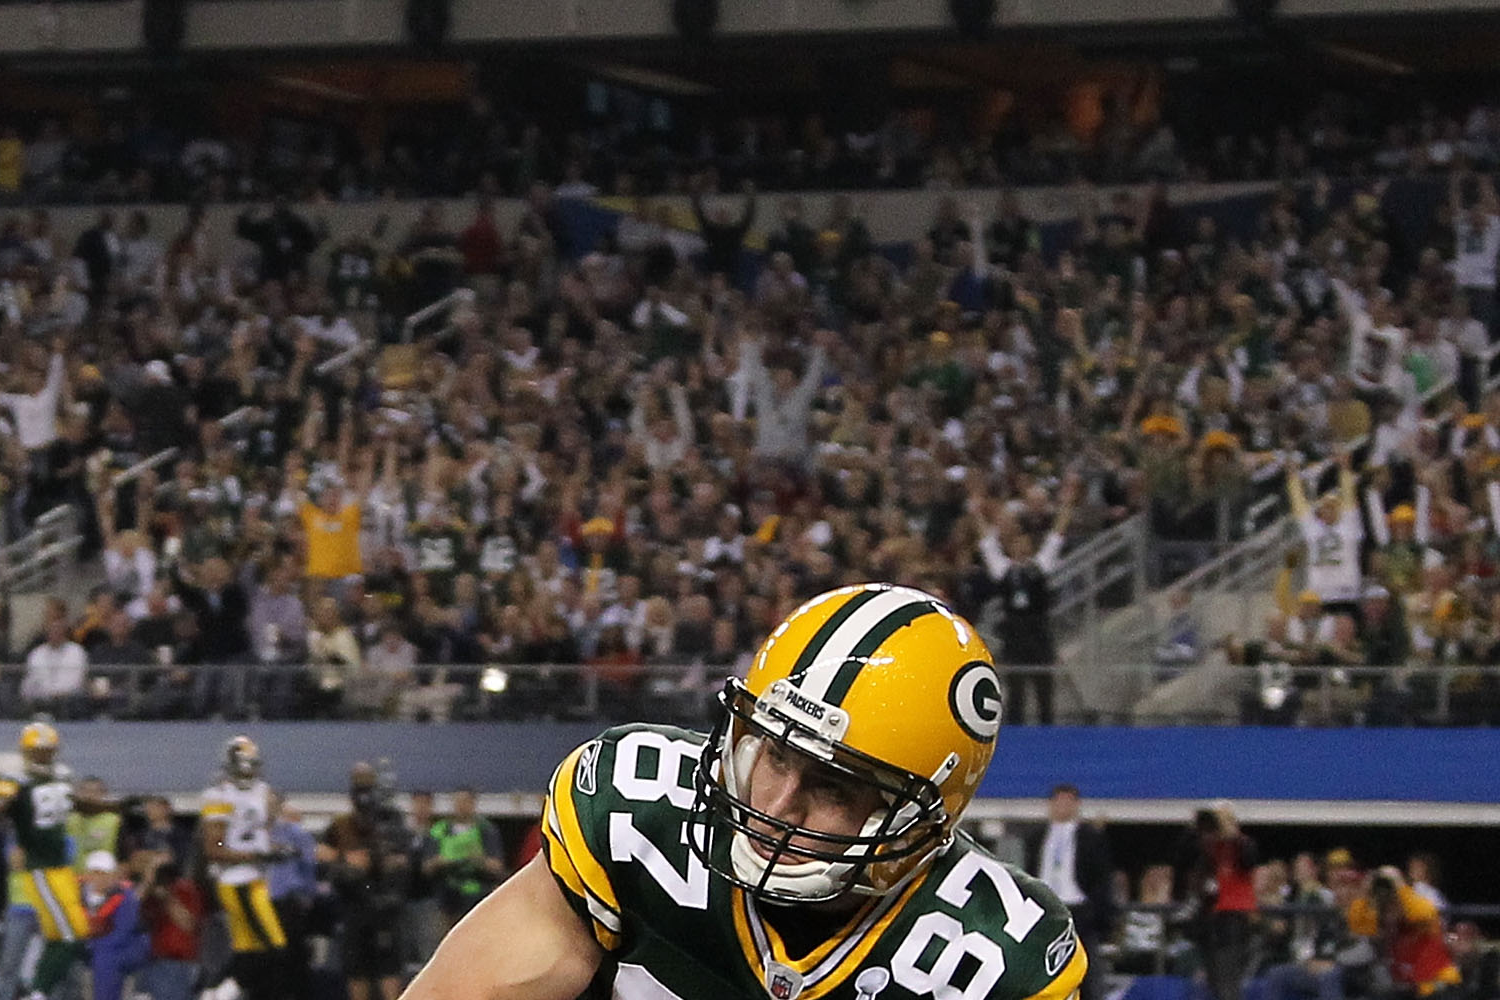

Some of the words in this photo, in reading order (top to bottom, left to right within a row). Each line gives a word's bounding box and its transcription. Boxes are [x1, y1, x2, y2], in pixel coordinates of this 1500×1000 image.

[785, 689, 827, 720] PACKERS
[955, 665, 1003, 738] G
[609, 731, 721, 910] 87
